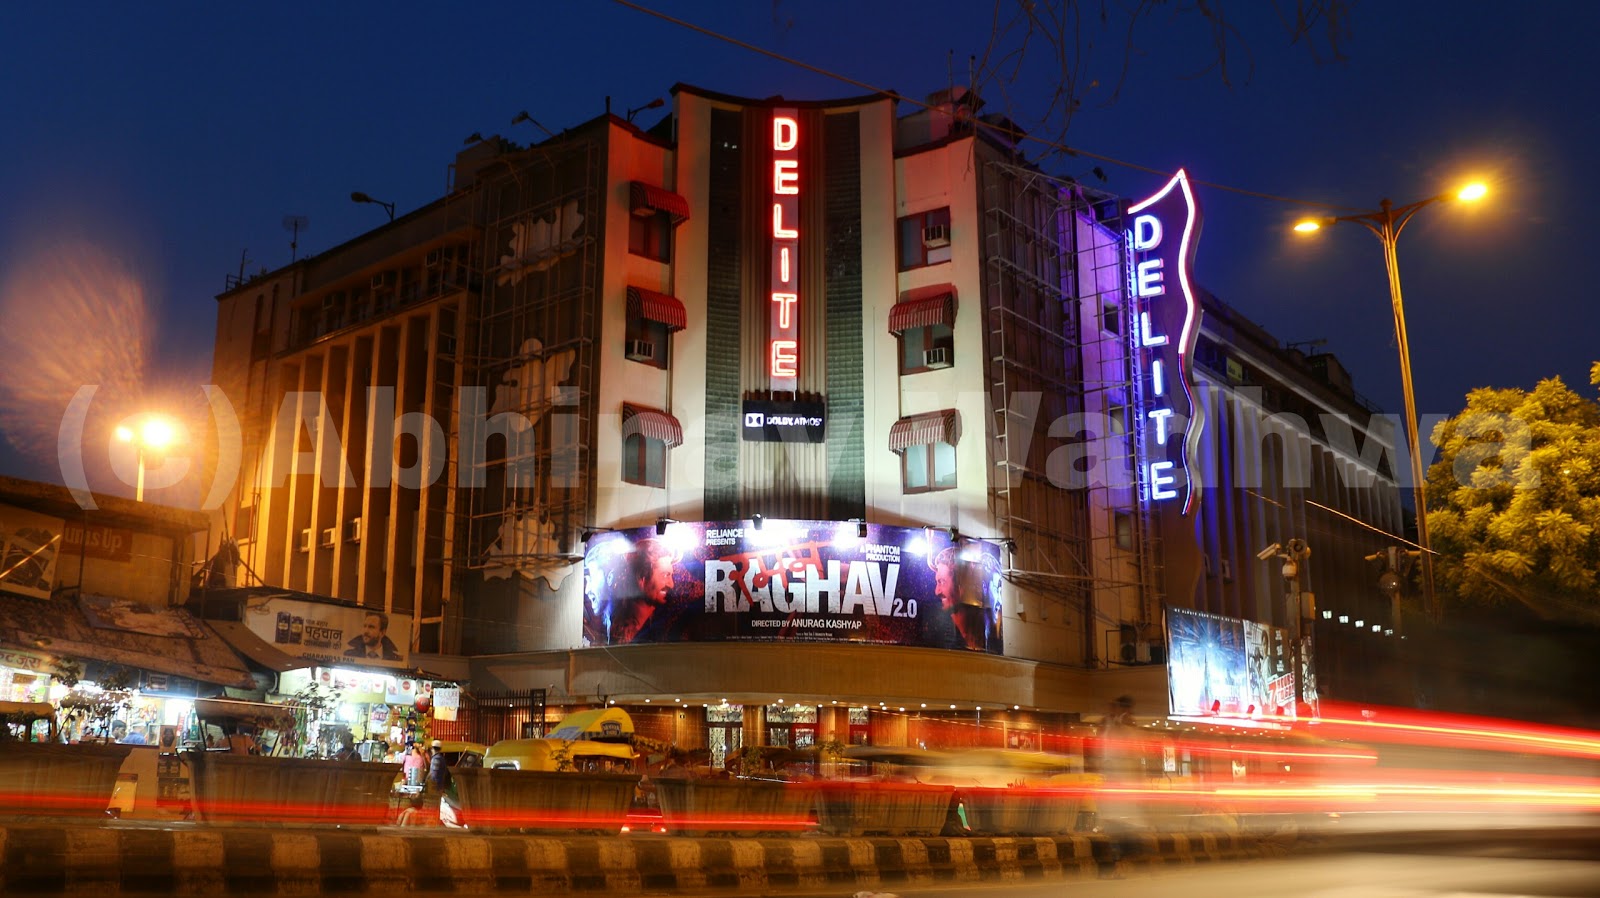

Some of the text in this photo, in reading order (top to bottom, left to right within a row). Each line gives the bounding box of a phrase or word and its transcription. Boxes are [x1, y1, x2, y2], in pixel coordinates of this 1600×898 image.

[772, 116, 799, 378] DELITE
[1133, 214, 1178, 502] DELITE
[766, 416, 793, 426] DOLBY
[706, 528, 744, 538] RELIANCE
[65, 527, 122, 553] ums Up
[706, 538, 736, 546] PRESENTS
[867, 544, 900, 555] PHANTOM
[865, 554, 900, 563] PRODUCTION
[704, 559, 918, 619] RAGHAV 2.0
[751, 618, 862, 630] DIRECTED BY ANURAG KASHYAP
[305, 626, 343, 641] पहचान
